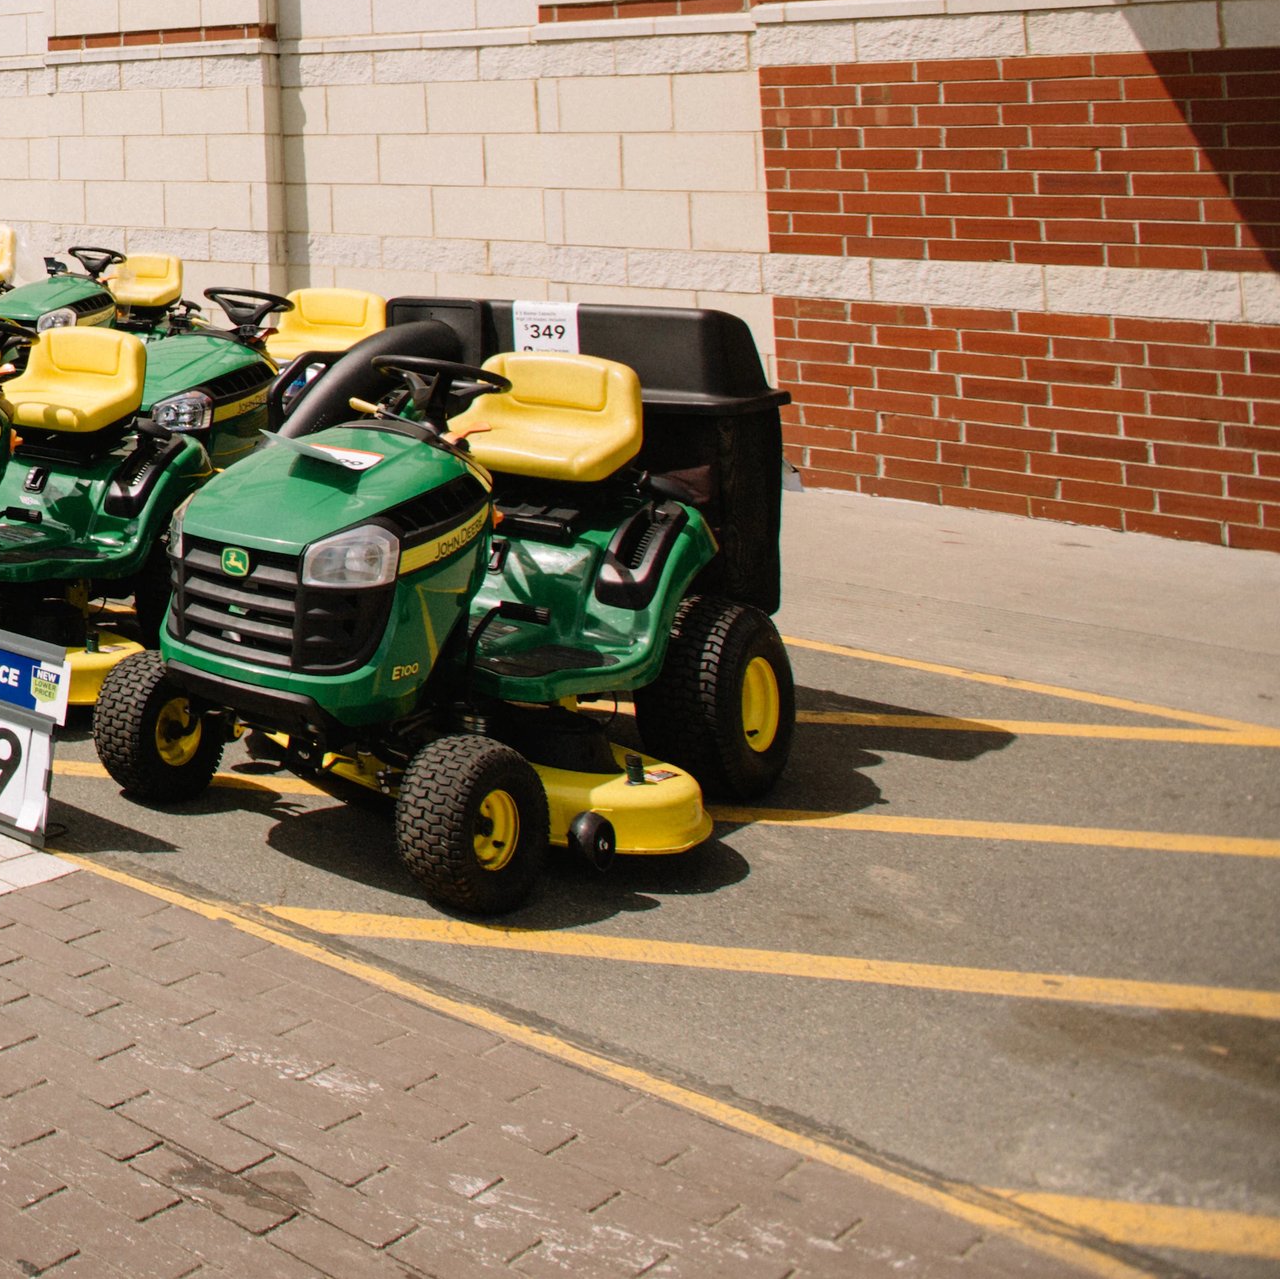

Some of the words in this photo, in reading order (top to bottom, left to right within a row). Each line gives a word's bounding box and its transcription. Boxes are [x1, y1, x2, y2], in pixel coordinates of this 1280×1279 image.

[434, 536, 460, 560] JOHN
[460, 514, 484, 544] DEERE
[36, 669, 57, 683] NEW
[391, 662, 419, 681] E100
[34, 679, 57, 691] LOWER
[34, 686, 55, 700] PRICE!
